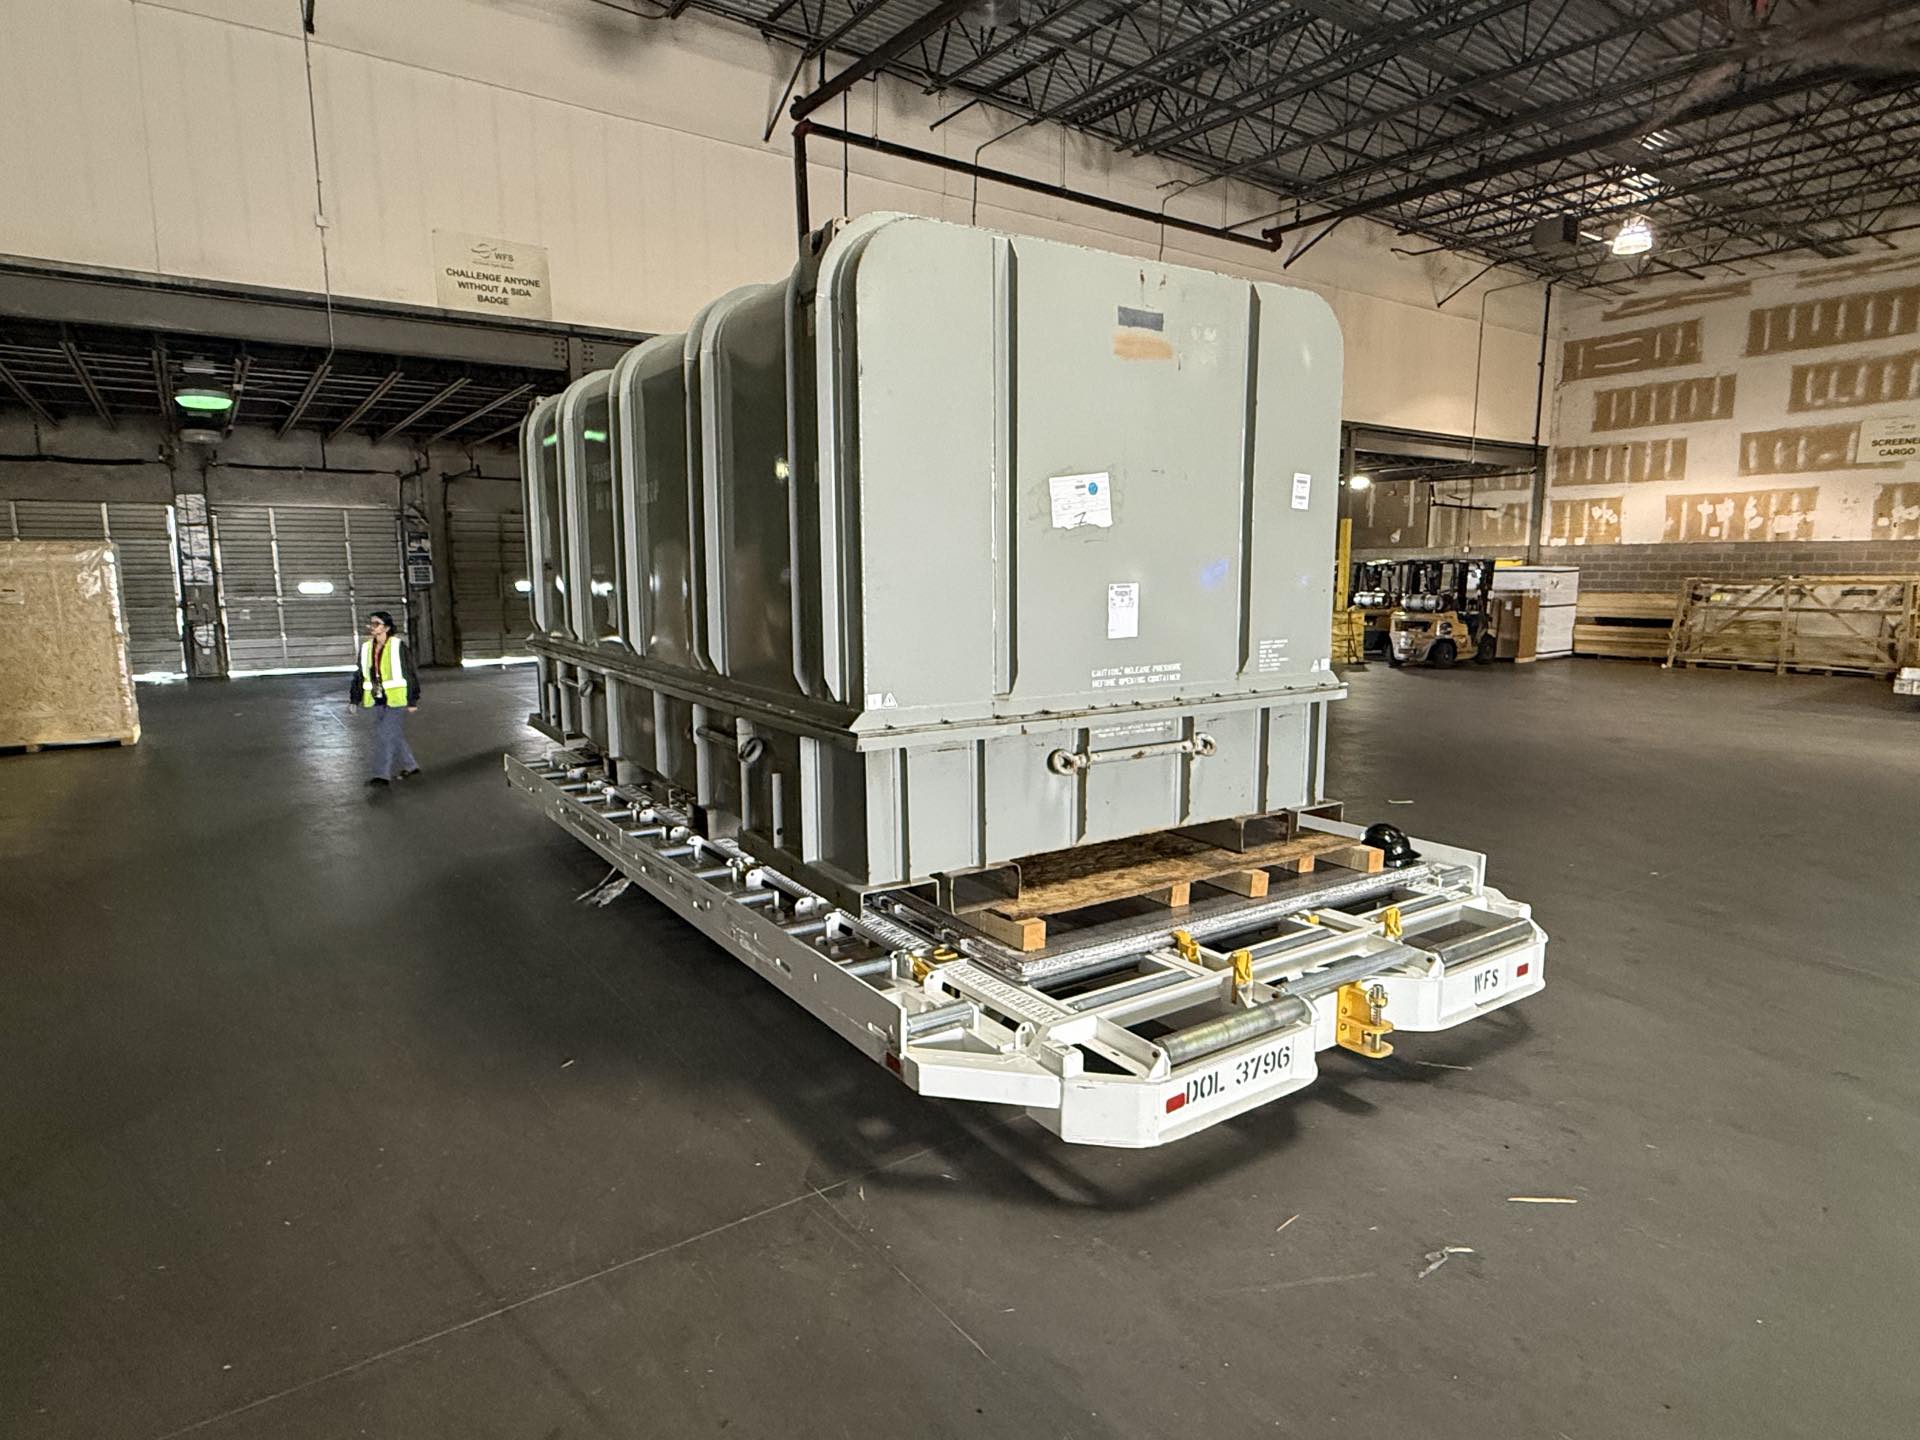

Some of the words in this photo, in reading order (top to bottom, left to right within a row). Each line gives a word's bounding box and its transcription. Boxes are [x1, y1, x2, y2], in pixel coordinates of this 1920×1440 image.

[494, 252, 514, 262] WFS
[446, 268, 502, 283] CHALLENGE
[504, 276, 541, 288] ANYONE
[457, 281, 499, 293] WITHOUT
[502, 287, 509, 295] A
[511, 287, 532, 298] SIDA
[477, 294, 510, 306] BADGE
[1871, 437, 1920, 447] SCREENE
[1879, 447, 1916, 457] CARGO
[1091, 678, 1116, 688] BEFORE
[1147, 673, 1182, 683] CONTAINER
[1474, 968, 1499, 994] WFS
[1186, 1071, 1226, 1105] DOL
[1236, 1046, 1290, 1085] 3796
